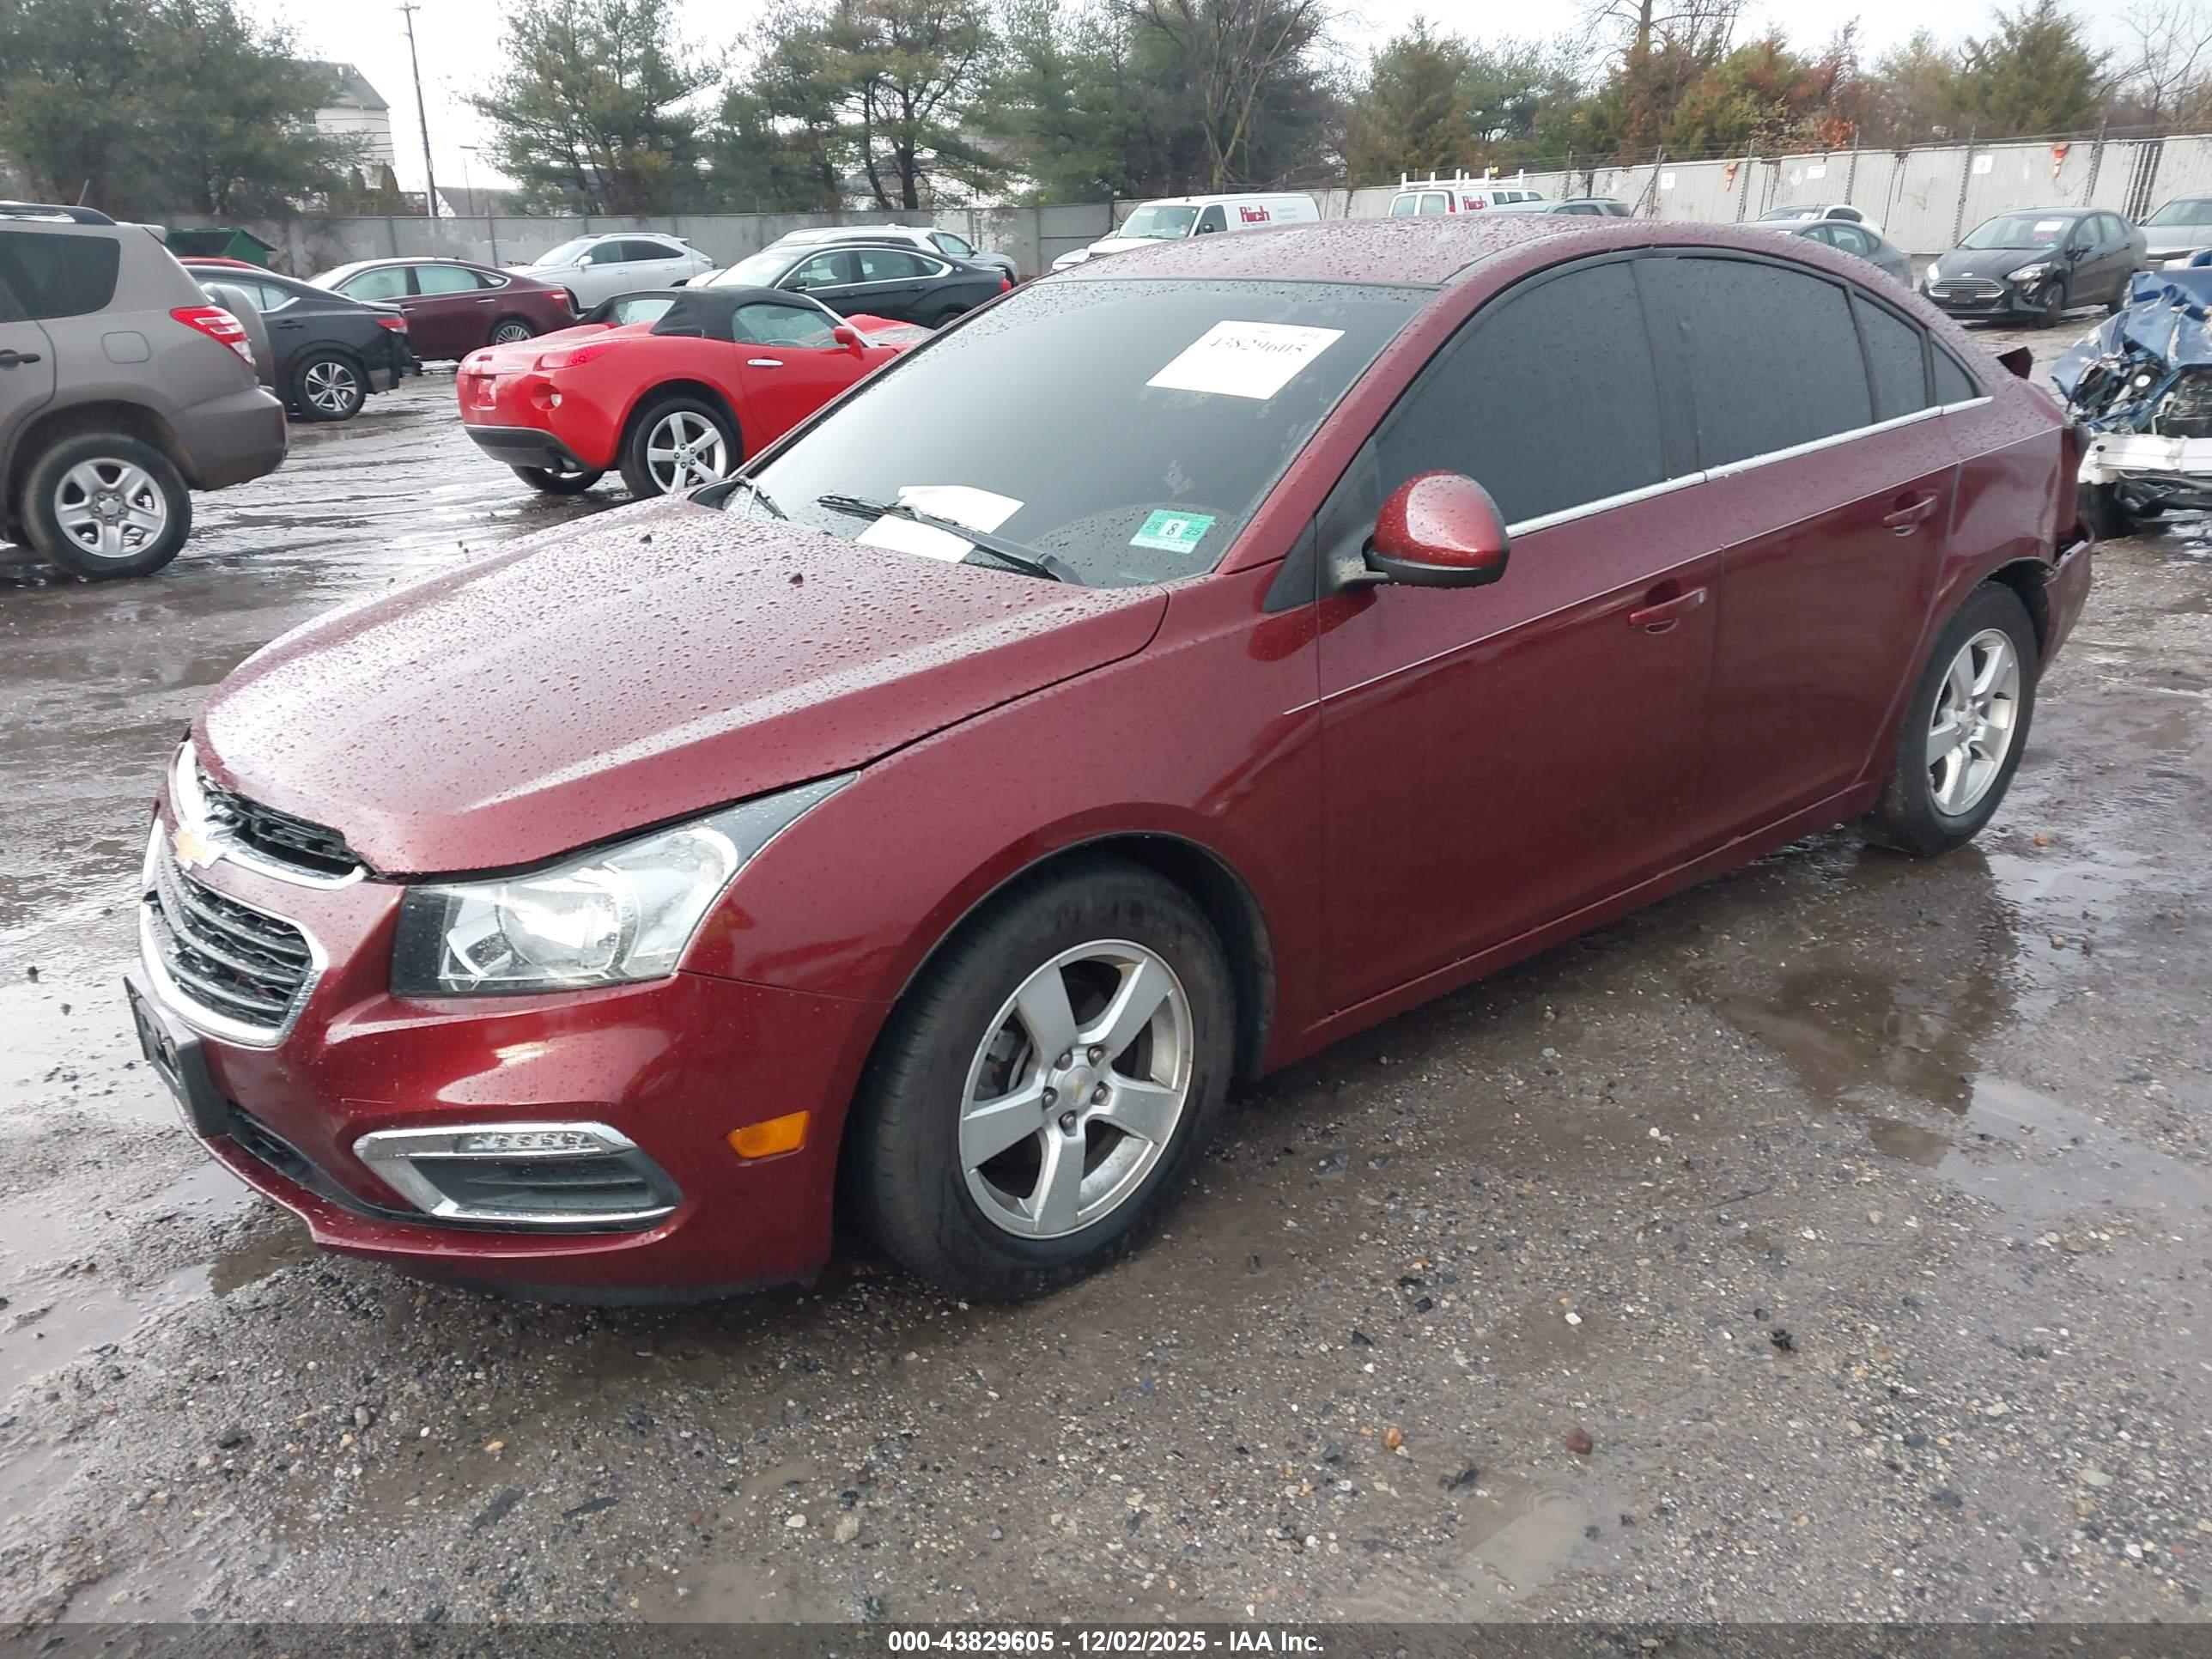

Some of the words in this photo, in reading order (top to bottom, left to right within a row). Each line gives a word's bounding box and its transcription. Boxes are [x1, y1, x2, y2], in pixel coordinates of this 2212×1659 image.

[1239, 205, 1271, 223] Rich
[1165, 522, 1180, 536] 8
[1185, 526, 1203, 537] 25
